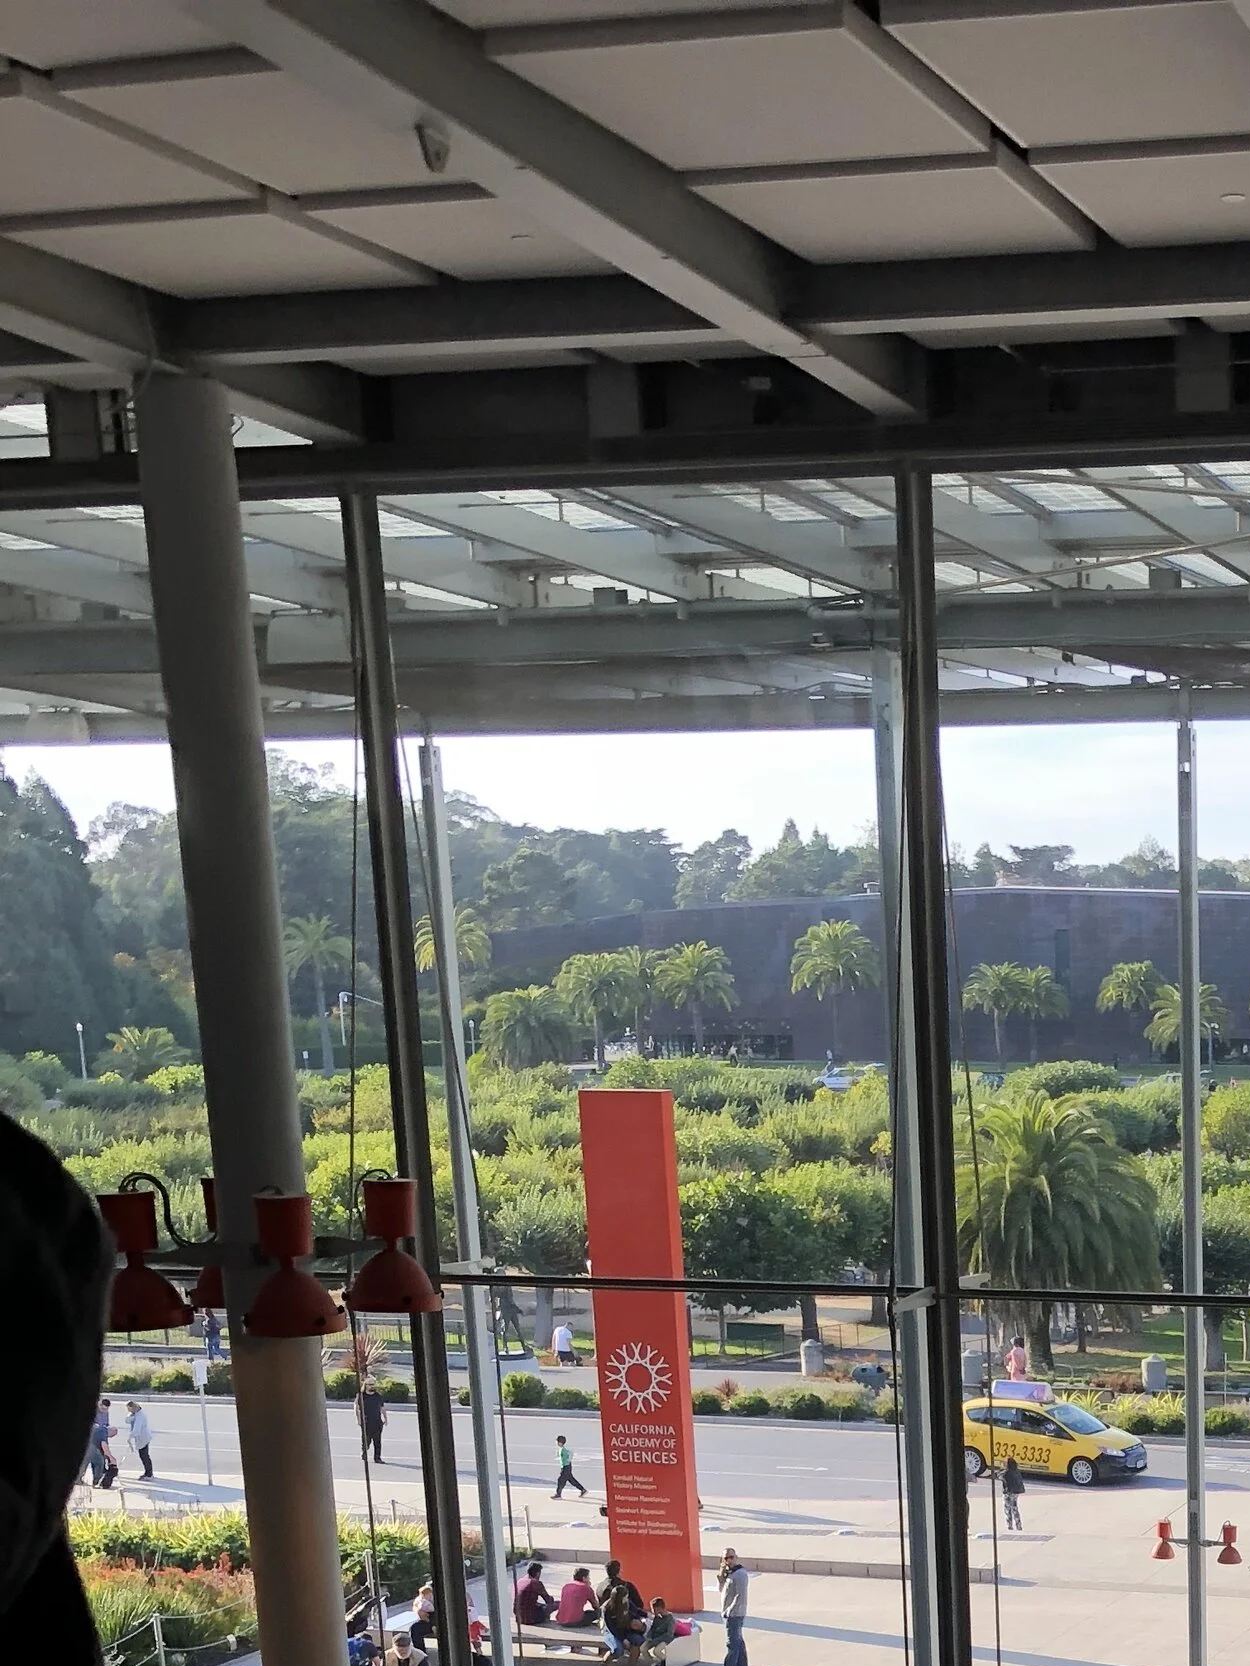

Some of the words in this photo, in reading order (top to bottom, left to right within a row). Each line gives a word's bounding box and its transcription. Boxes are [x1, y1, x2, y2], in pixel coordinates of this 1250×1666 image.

[609, 1424, 676, 1435] CALIFORNIA
[611, 1437, 661, 1448] ACADEMY
[662, 1439, 677, 1449] OF
[611, 1450, 677, 1464] SCIENCES
